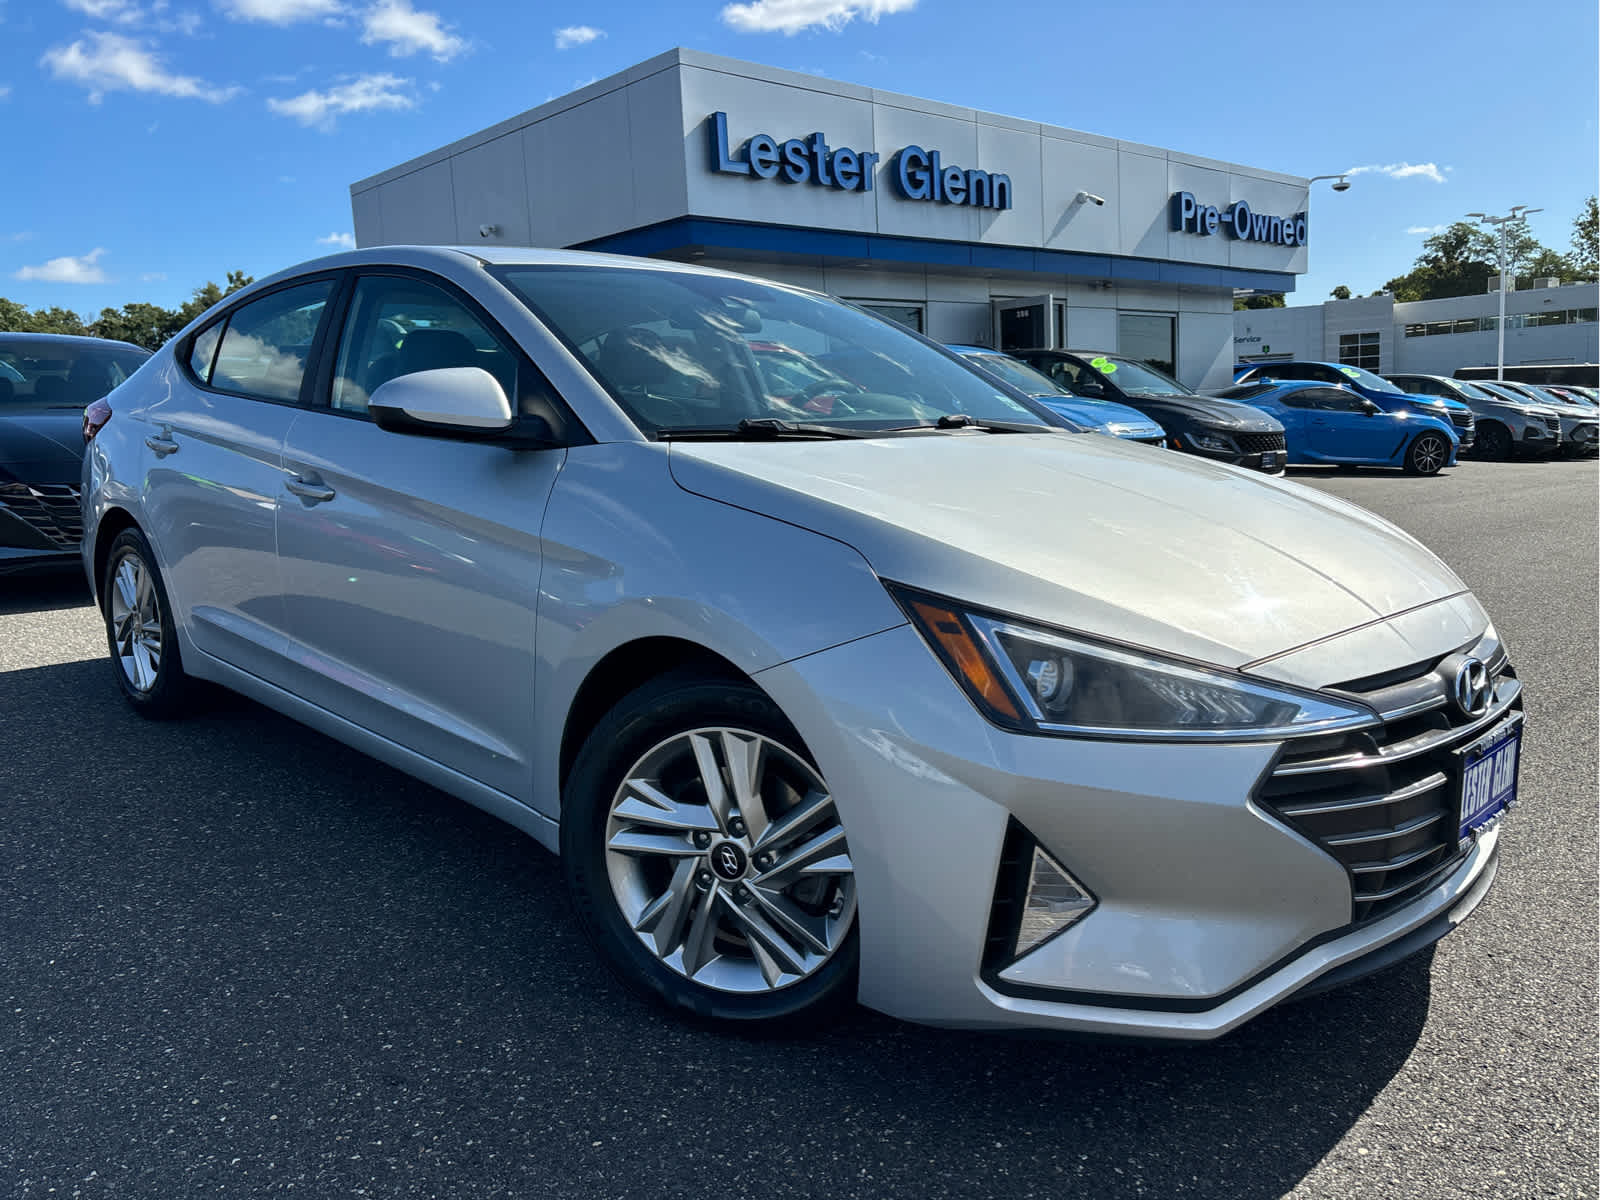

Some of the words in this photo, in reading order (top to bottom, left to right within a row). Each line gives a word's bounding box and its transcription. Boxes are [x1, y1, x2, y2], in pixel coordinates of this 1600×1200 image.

[709, 111, 879, 191] Lester
[896, 145, 1013, 210] Glenn
[1171, 191, 1308, 247] Pre-Owned
[1233, 336, 1262, 344] Service
[1460, 755, 1493, 821] LESTER
